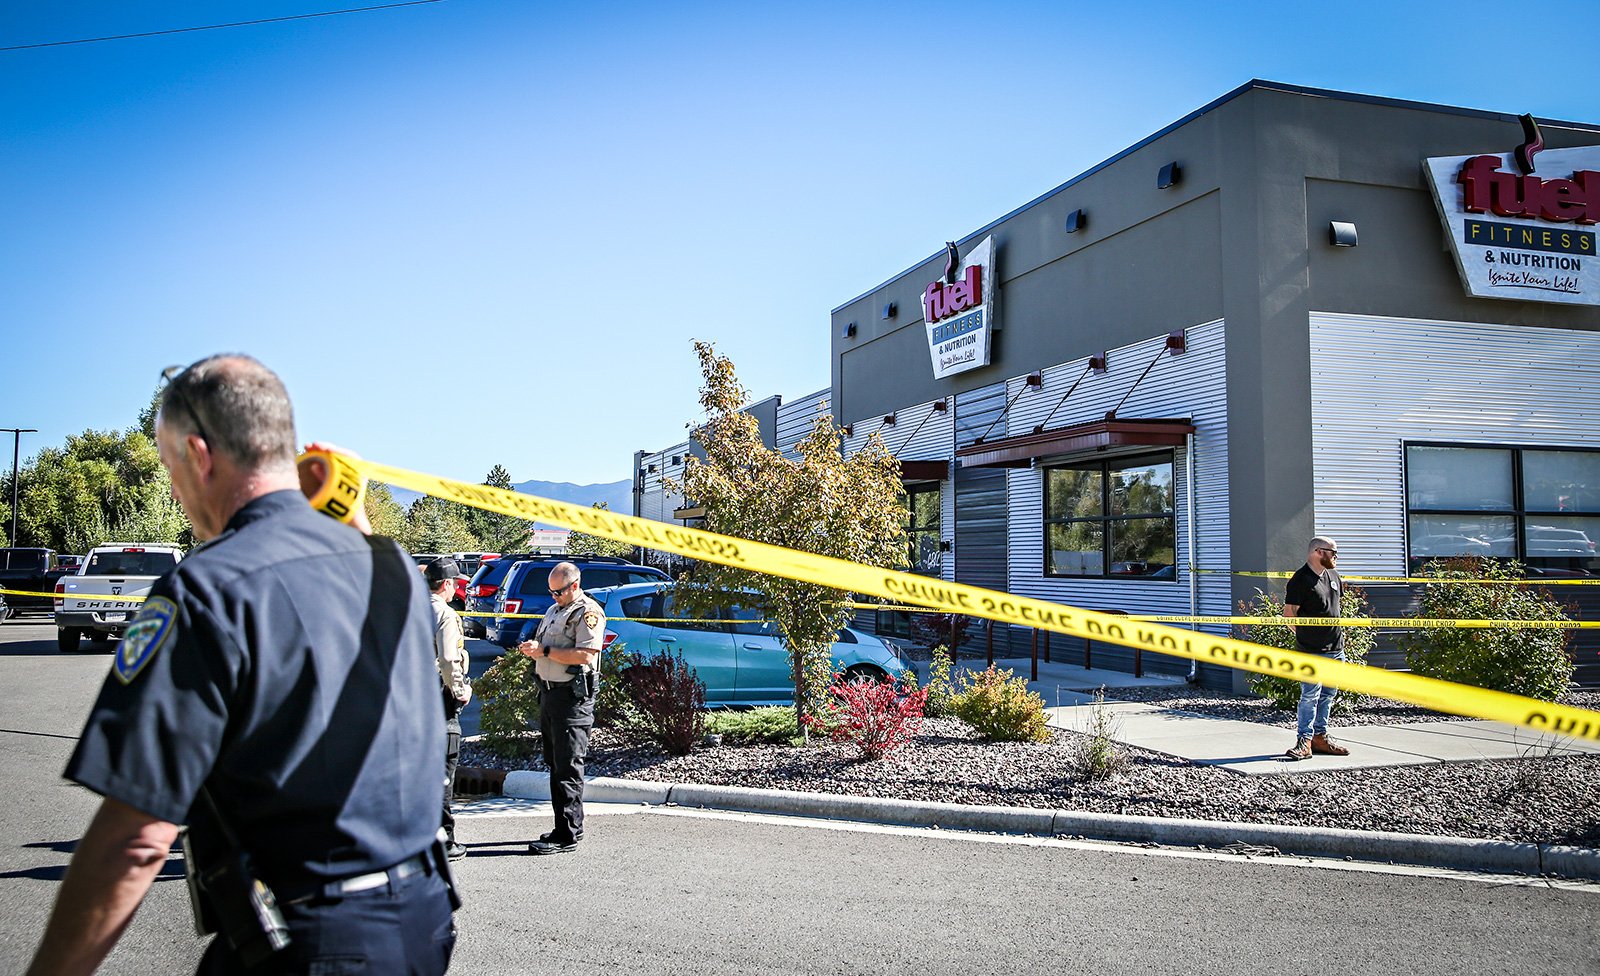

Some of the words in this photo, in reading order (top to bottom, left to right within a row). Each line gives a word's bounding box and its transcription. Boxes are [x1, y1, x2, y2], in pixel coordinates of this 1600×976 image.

[1457, 155, 1600, 224] fuel
[1471, 224, 1590, 250] FITNESS
[1485, 250, 1495, 263] &
[1500, 251, 1581, 271] NUTRITION
[1488, 268, 1521, 286] Ignite
[1522, 271, 1550, 286] Your
[1553, 275, 1578, 292] Life!
[924, 265, 981, 323] fuel
[934, 314, 981, 341] FITNESS
[944, 333, 976, 353] NUTRITION
